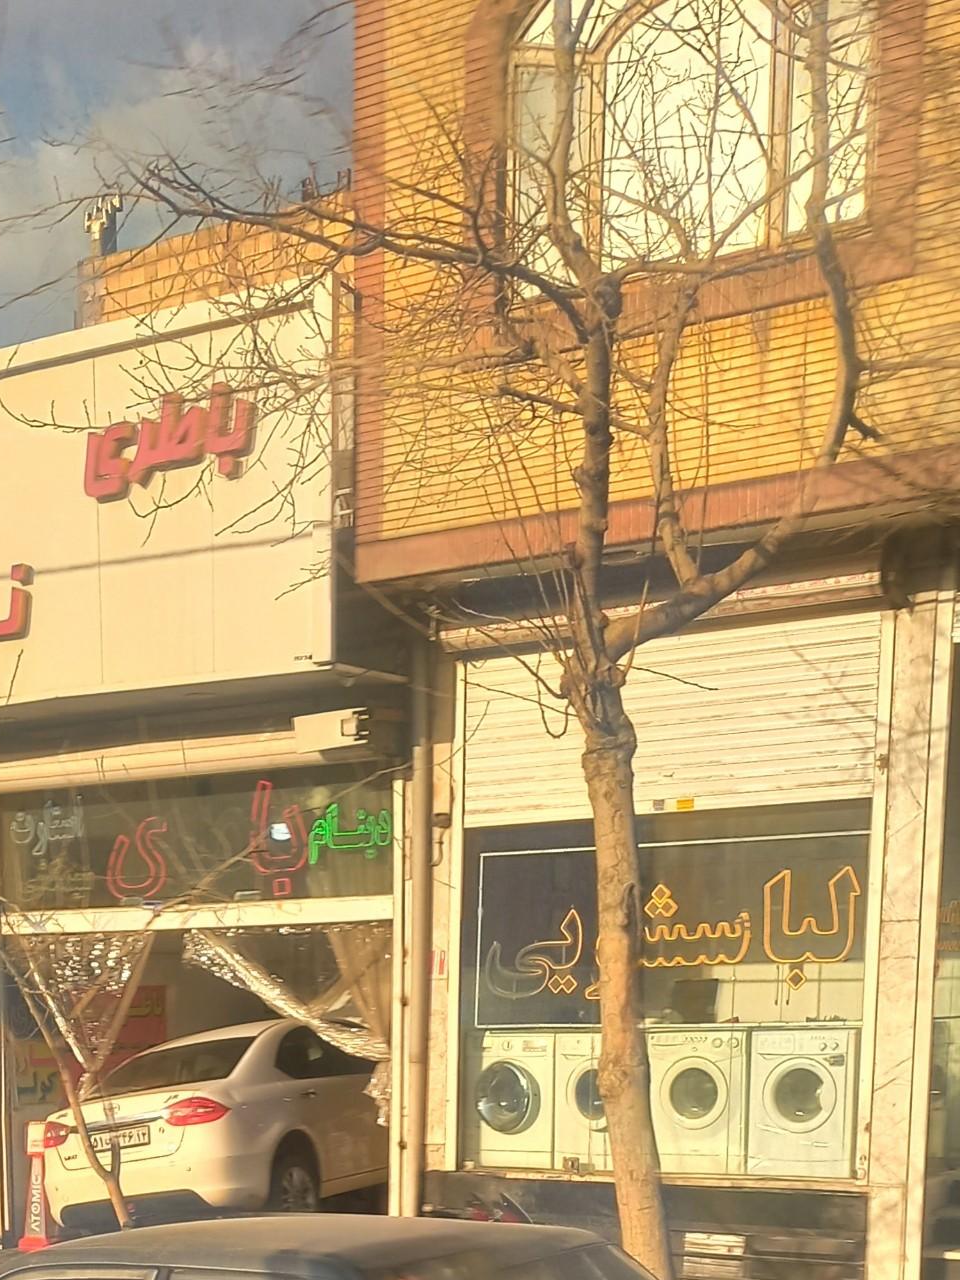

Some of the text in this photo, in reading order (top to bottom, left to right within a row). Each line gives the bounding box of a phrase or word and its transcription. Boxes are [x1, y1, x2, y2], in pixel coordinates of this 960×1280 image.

[85, 382, 258, 503] باطری
[308, 803, 392, 865] دینام
[30, 1173, 42, 1233] ATOMIC
